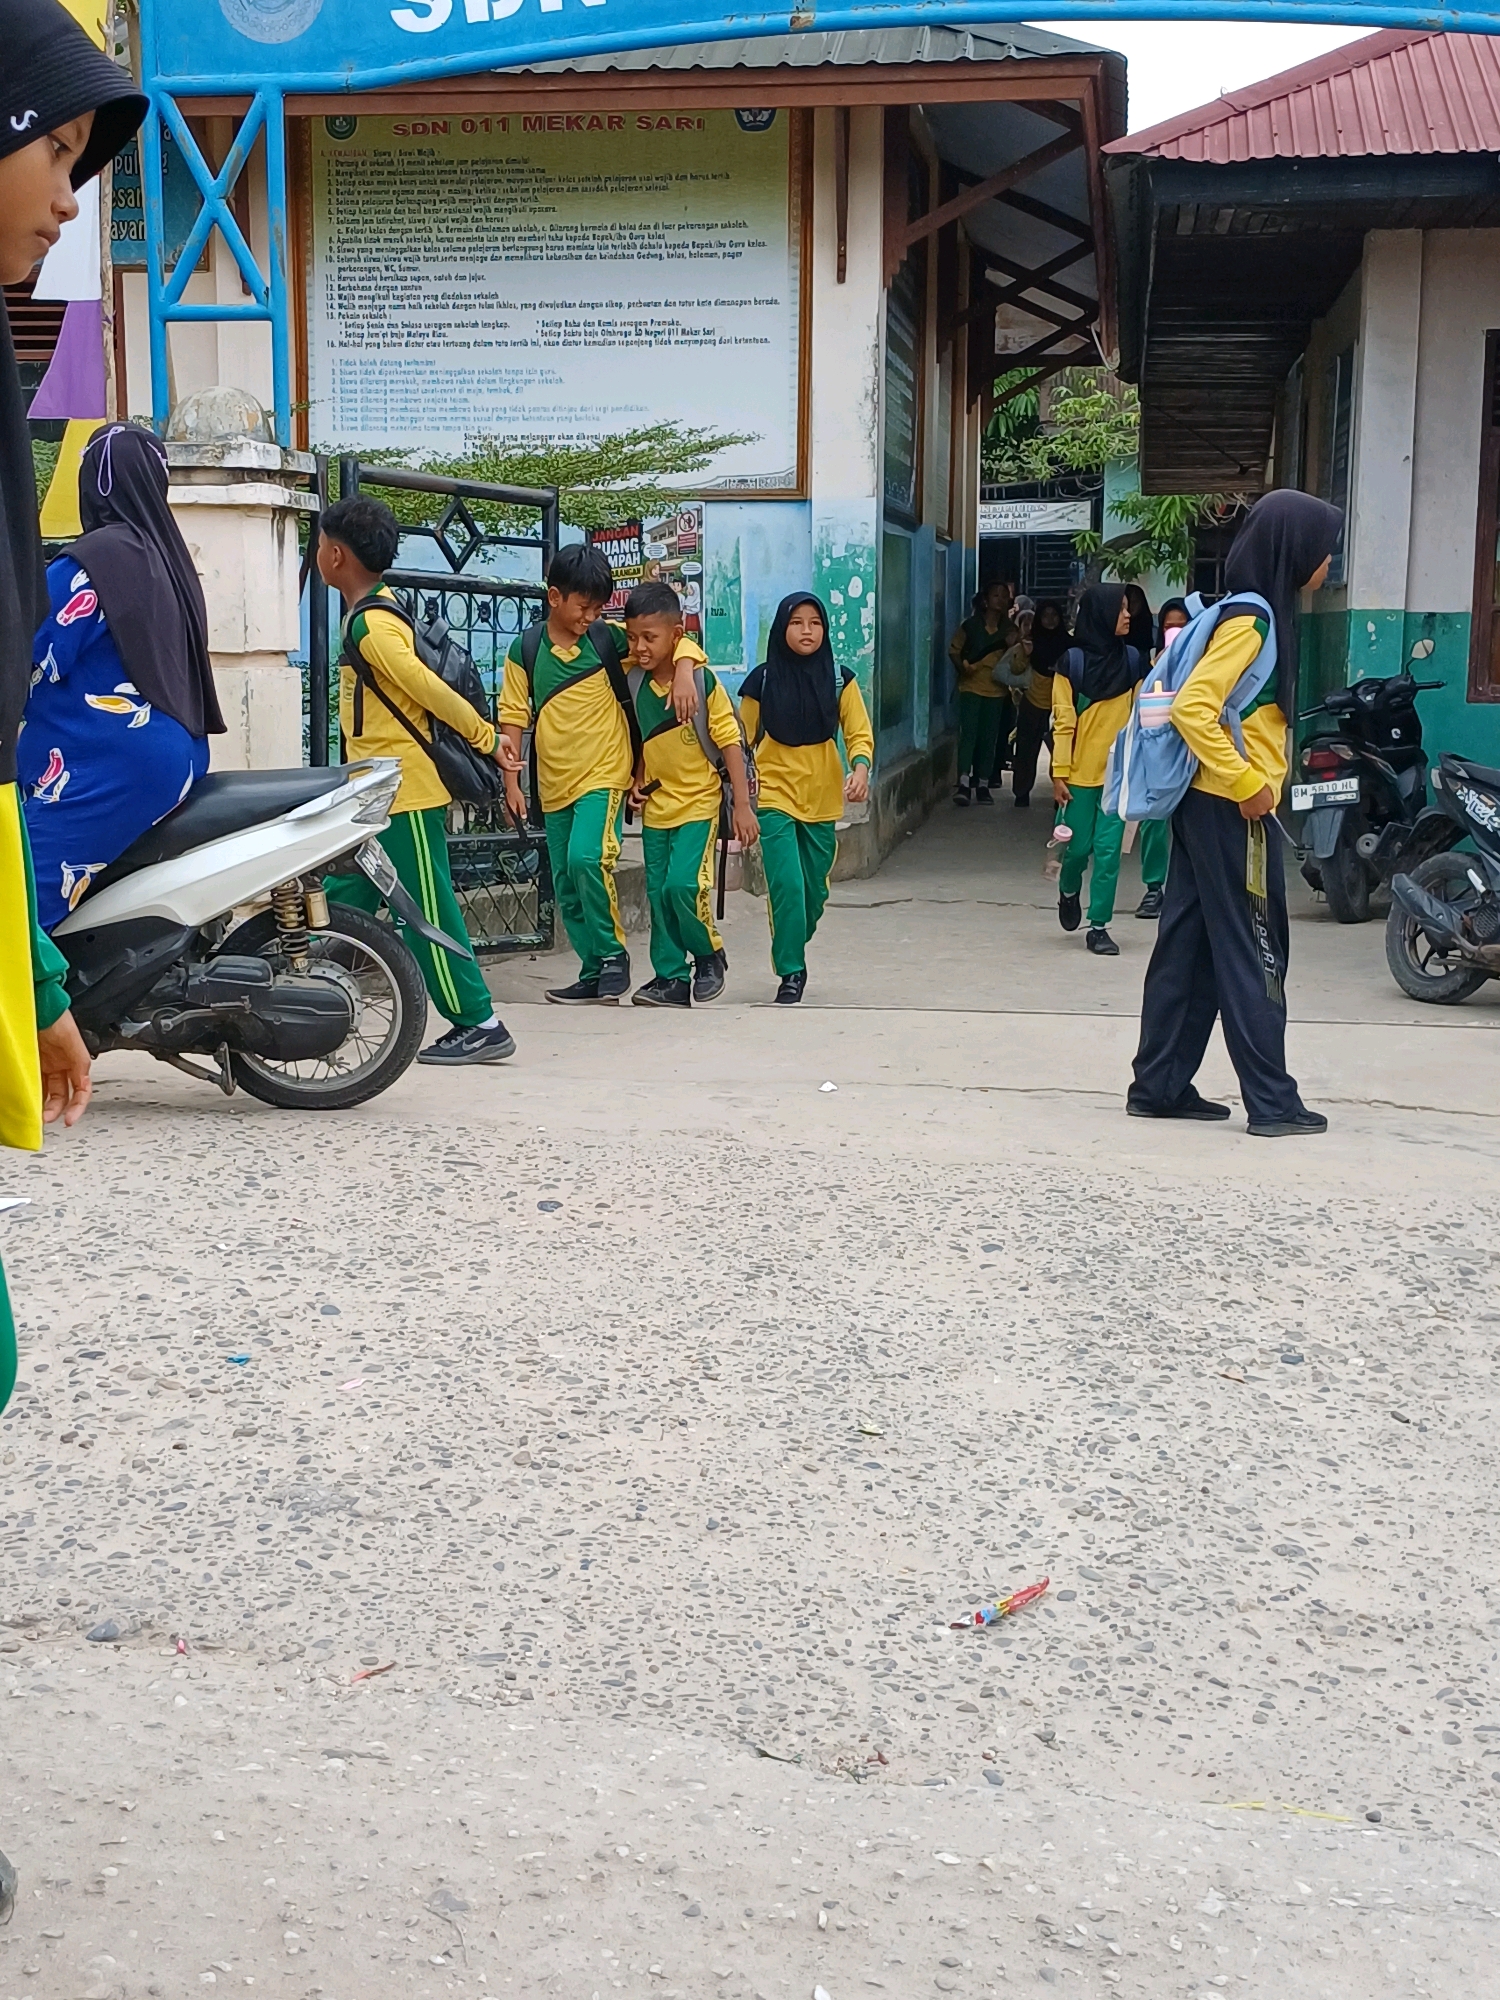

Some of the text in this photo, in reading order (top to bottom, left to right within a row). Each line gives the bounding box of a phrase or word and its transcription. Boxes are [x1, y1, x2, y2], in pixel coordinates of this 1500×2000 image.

[393, 114, 705, 137] SDN 011 MEKAR SARI
[592, 525, 639, 542] JANGAN
[608, 552, 641, 569] MPAH
[616, 578, 639, 590] KENA
[1255, 911, 1277, 978] SPORT
